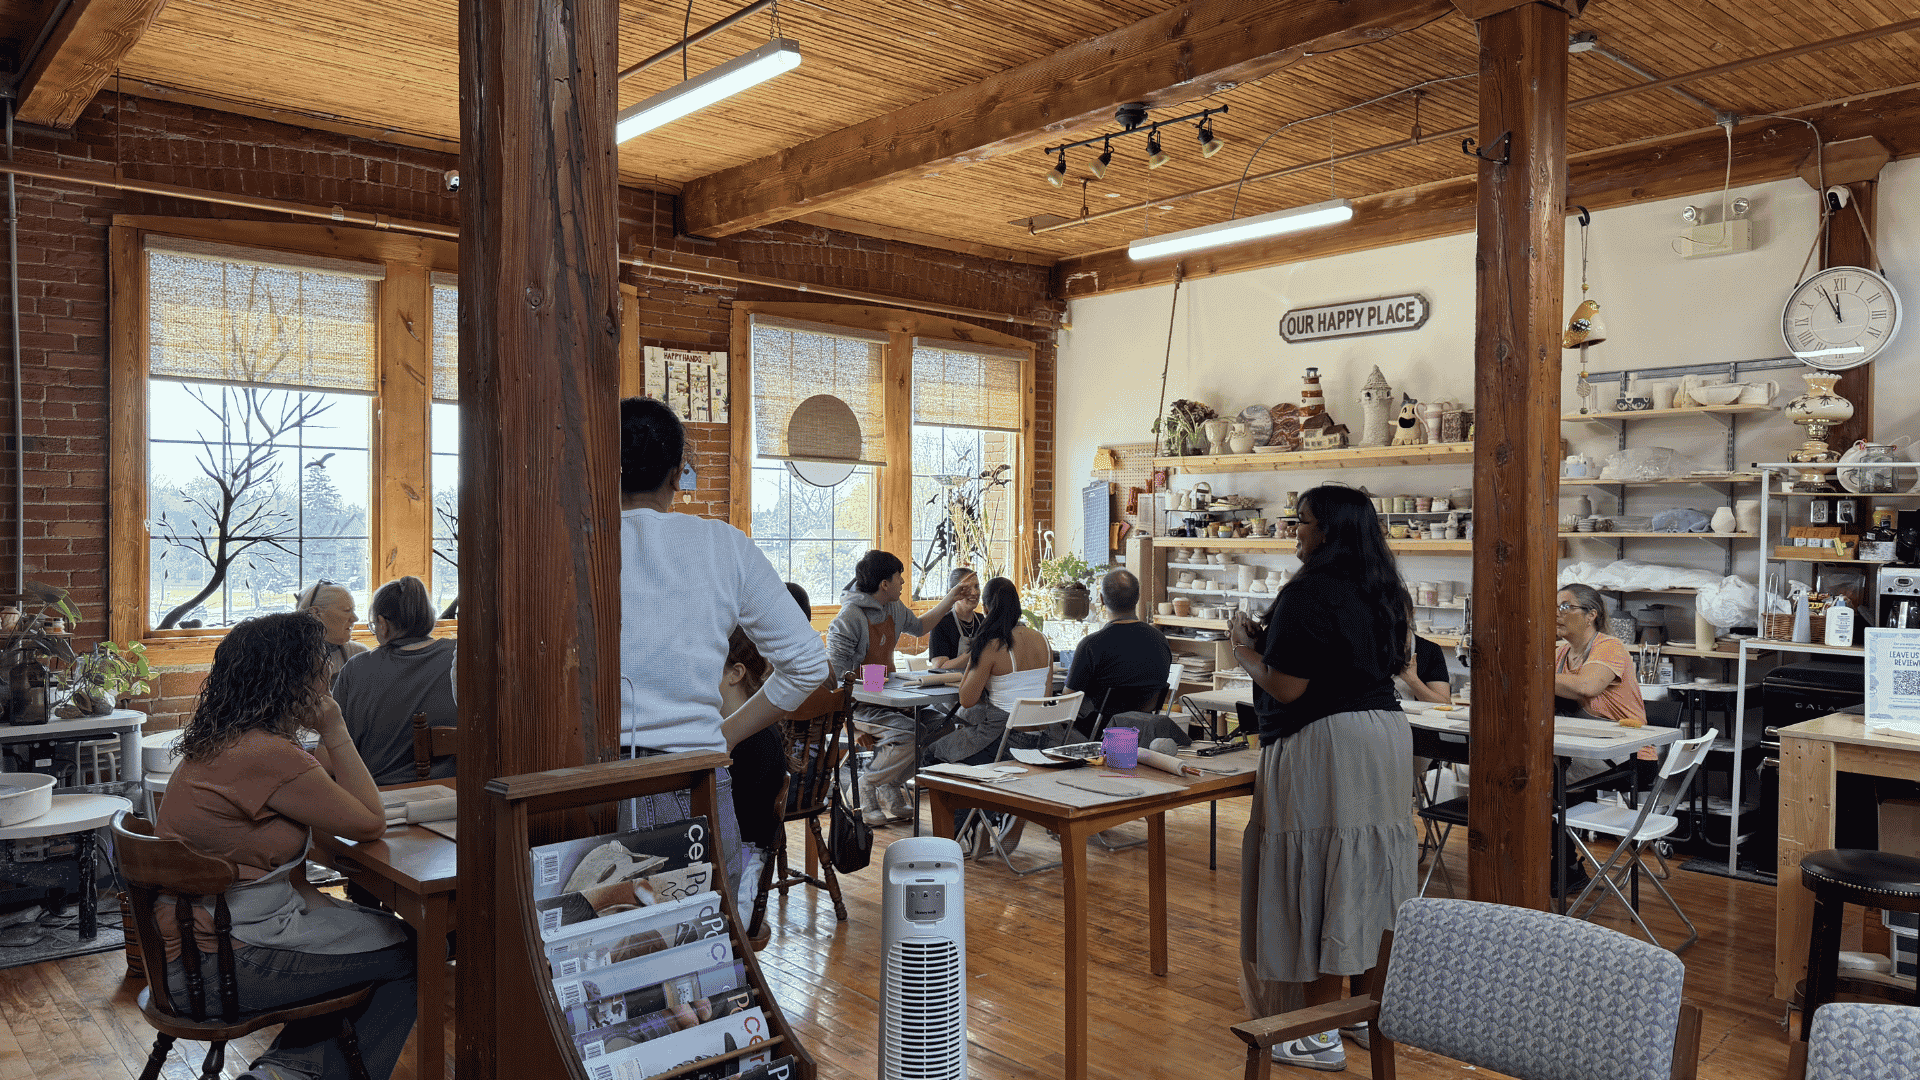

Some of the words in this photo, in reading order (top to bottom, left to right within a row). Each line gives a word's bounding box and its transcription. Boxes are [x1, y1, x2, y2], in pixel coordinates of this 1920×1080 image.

[1833, 277, 1847, 292] XII
[1287, 314, 1314, 336] OUR
[1317, 307, 1364, 333] HAPPY
[1367, 301, 1416, 327] PLACE
[664, 352, 681, 361] HAPPY
[683, 353, 702, 363] HANDS
